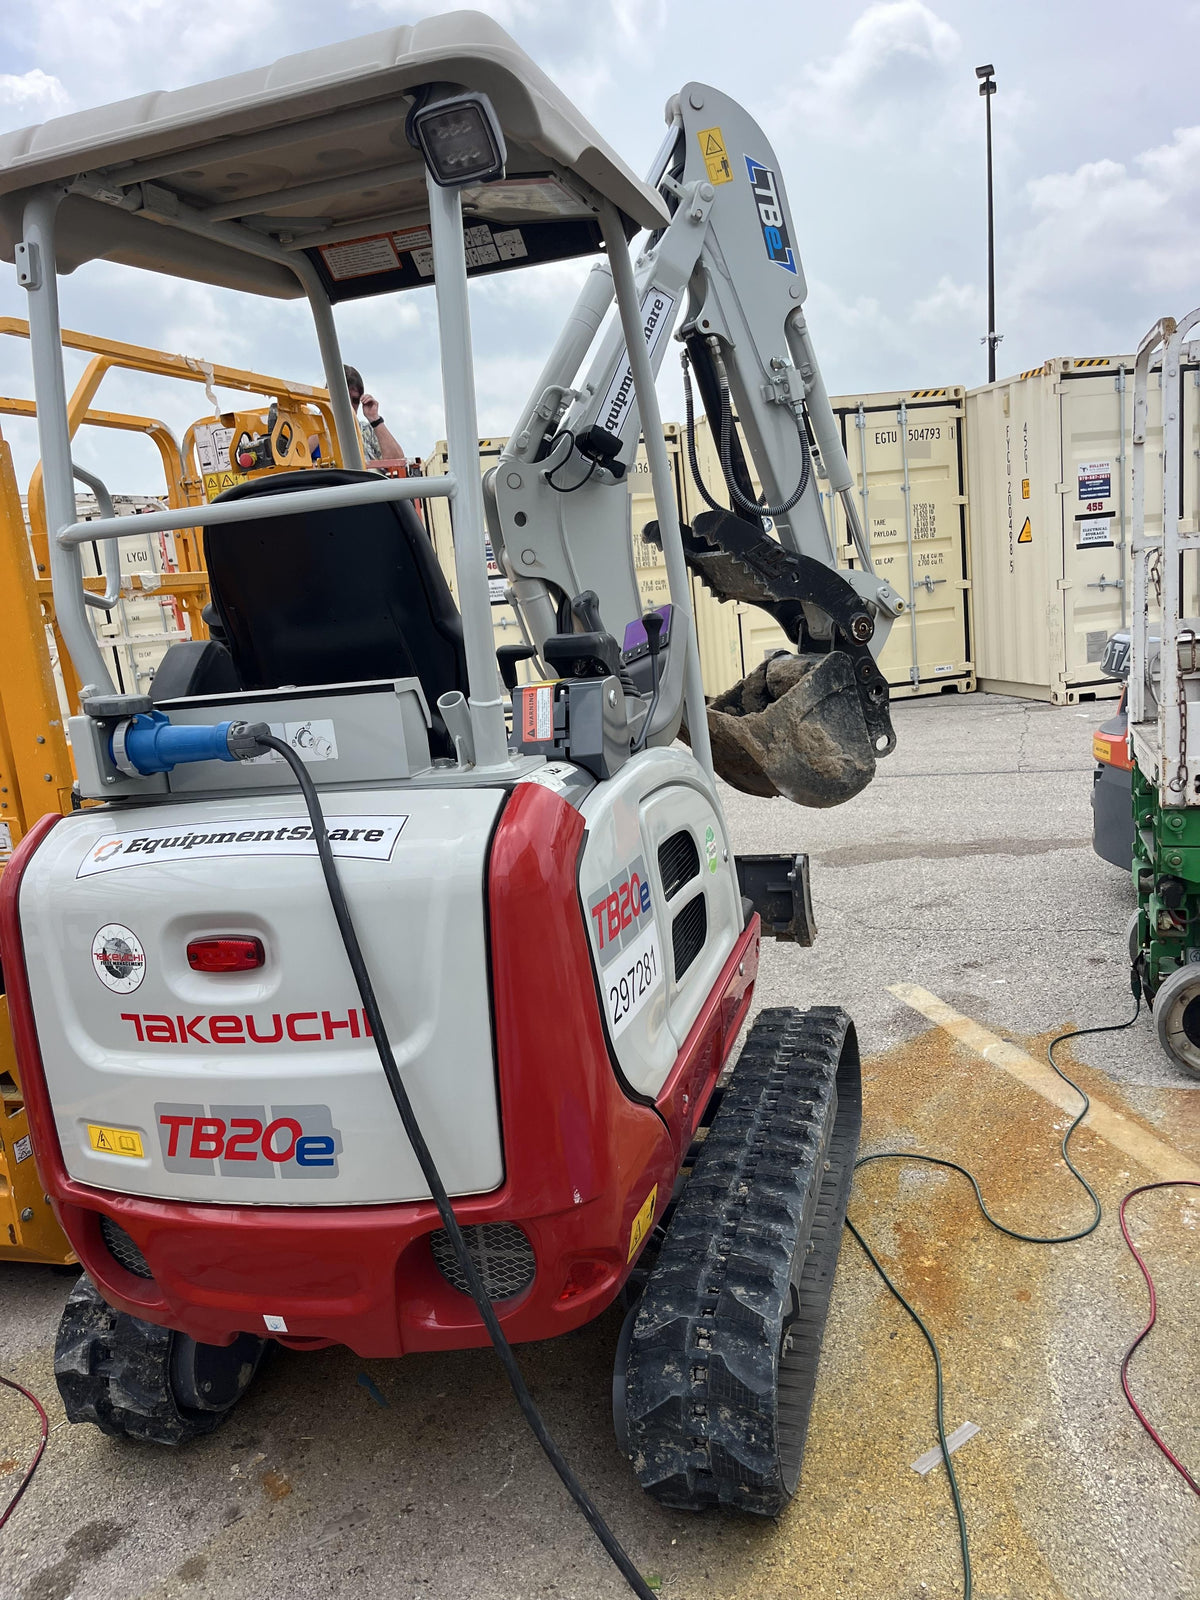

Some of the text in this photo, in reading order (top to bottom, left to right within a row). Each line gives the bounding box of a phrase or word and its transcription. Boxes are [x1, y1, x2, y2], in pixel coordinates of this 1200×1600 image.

[875, 431, 897, 445] EGTU
[908, 427, 941, 442] 504793
[1086, 502, 1103, 512] 455
[873, 519, 887, 527] TARE
[873, 529, 898, 538] PAYLOAD
[126, 551, 148, 563] LYGU
[591, 872, 651, 950] TB20e
[609, 943, 658, 1025] 297281
[159, 1114, 335, 1167] TB20e
